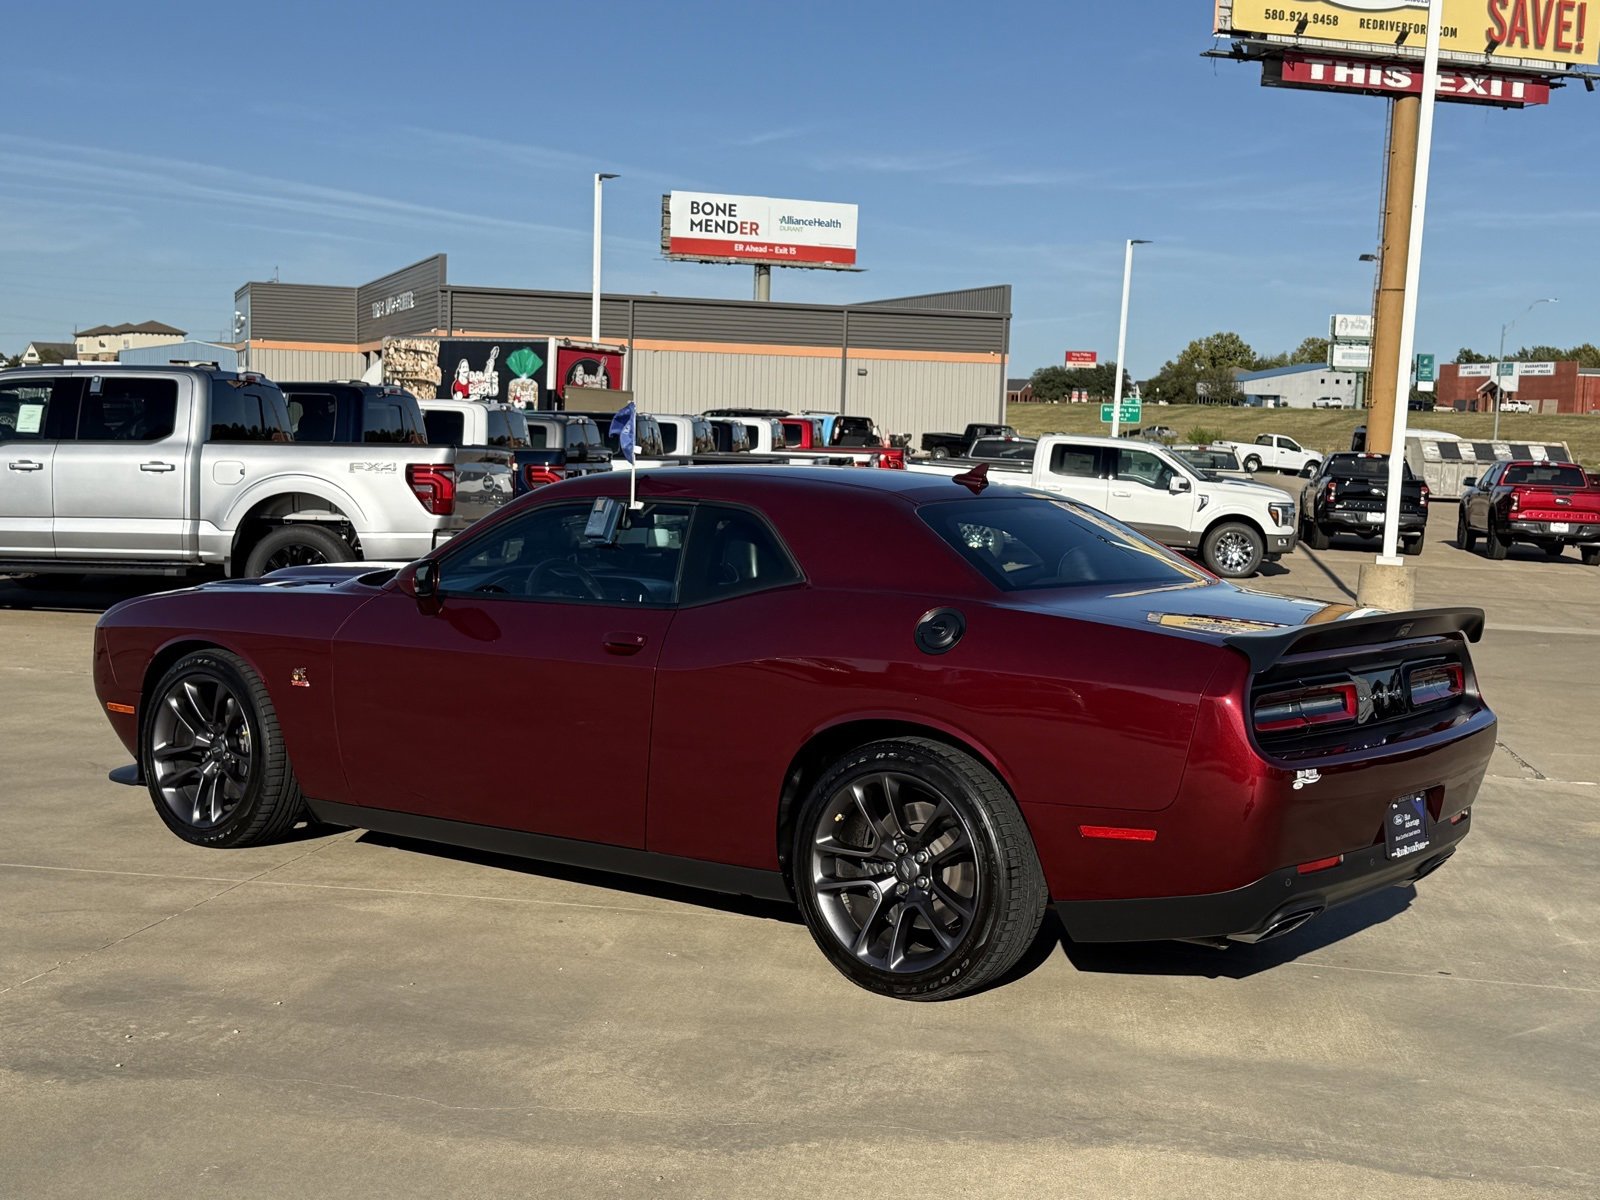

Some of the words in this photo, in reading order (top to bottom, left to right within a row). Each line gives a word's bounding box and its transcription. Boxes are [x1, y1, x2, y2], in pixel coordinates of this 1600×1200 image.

[1264, 8, 1339, 26] 580.924.9458
[1359, 17, 1458, 38] REDRIVERFORCOM
[1485, 0, 1587, 54] SAVE!
[1304, 58, 1413, 88] THIS
[1435, 71, 1533, 99] EXIT
[690, 200, 737, 217] BONE
[690, 217, 760, 236] MENDER
[779, 215, 842, 229] AllianceHealth
[734, 243, 745, 252] ER
[745, 244, 768, 254] Ahead
[775, 246, 789, 255] Exit
[789, 246, 797, 256] 15
[349, 462, 397, 473] FX4
